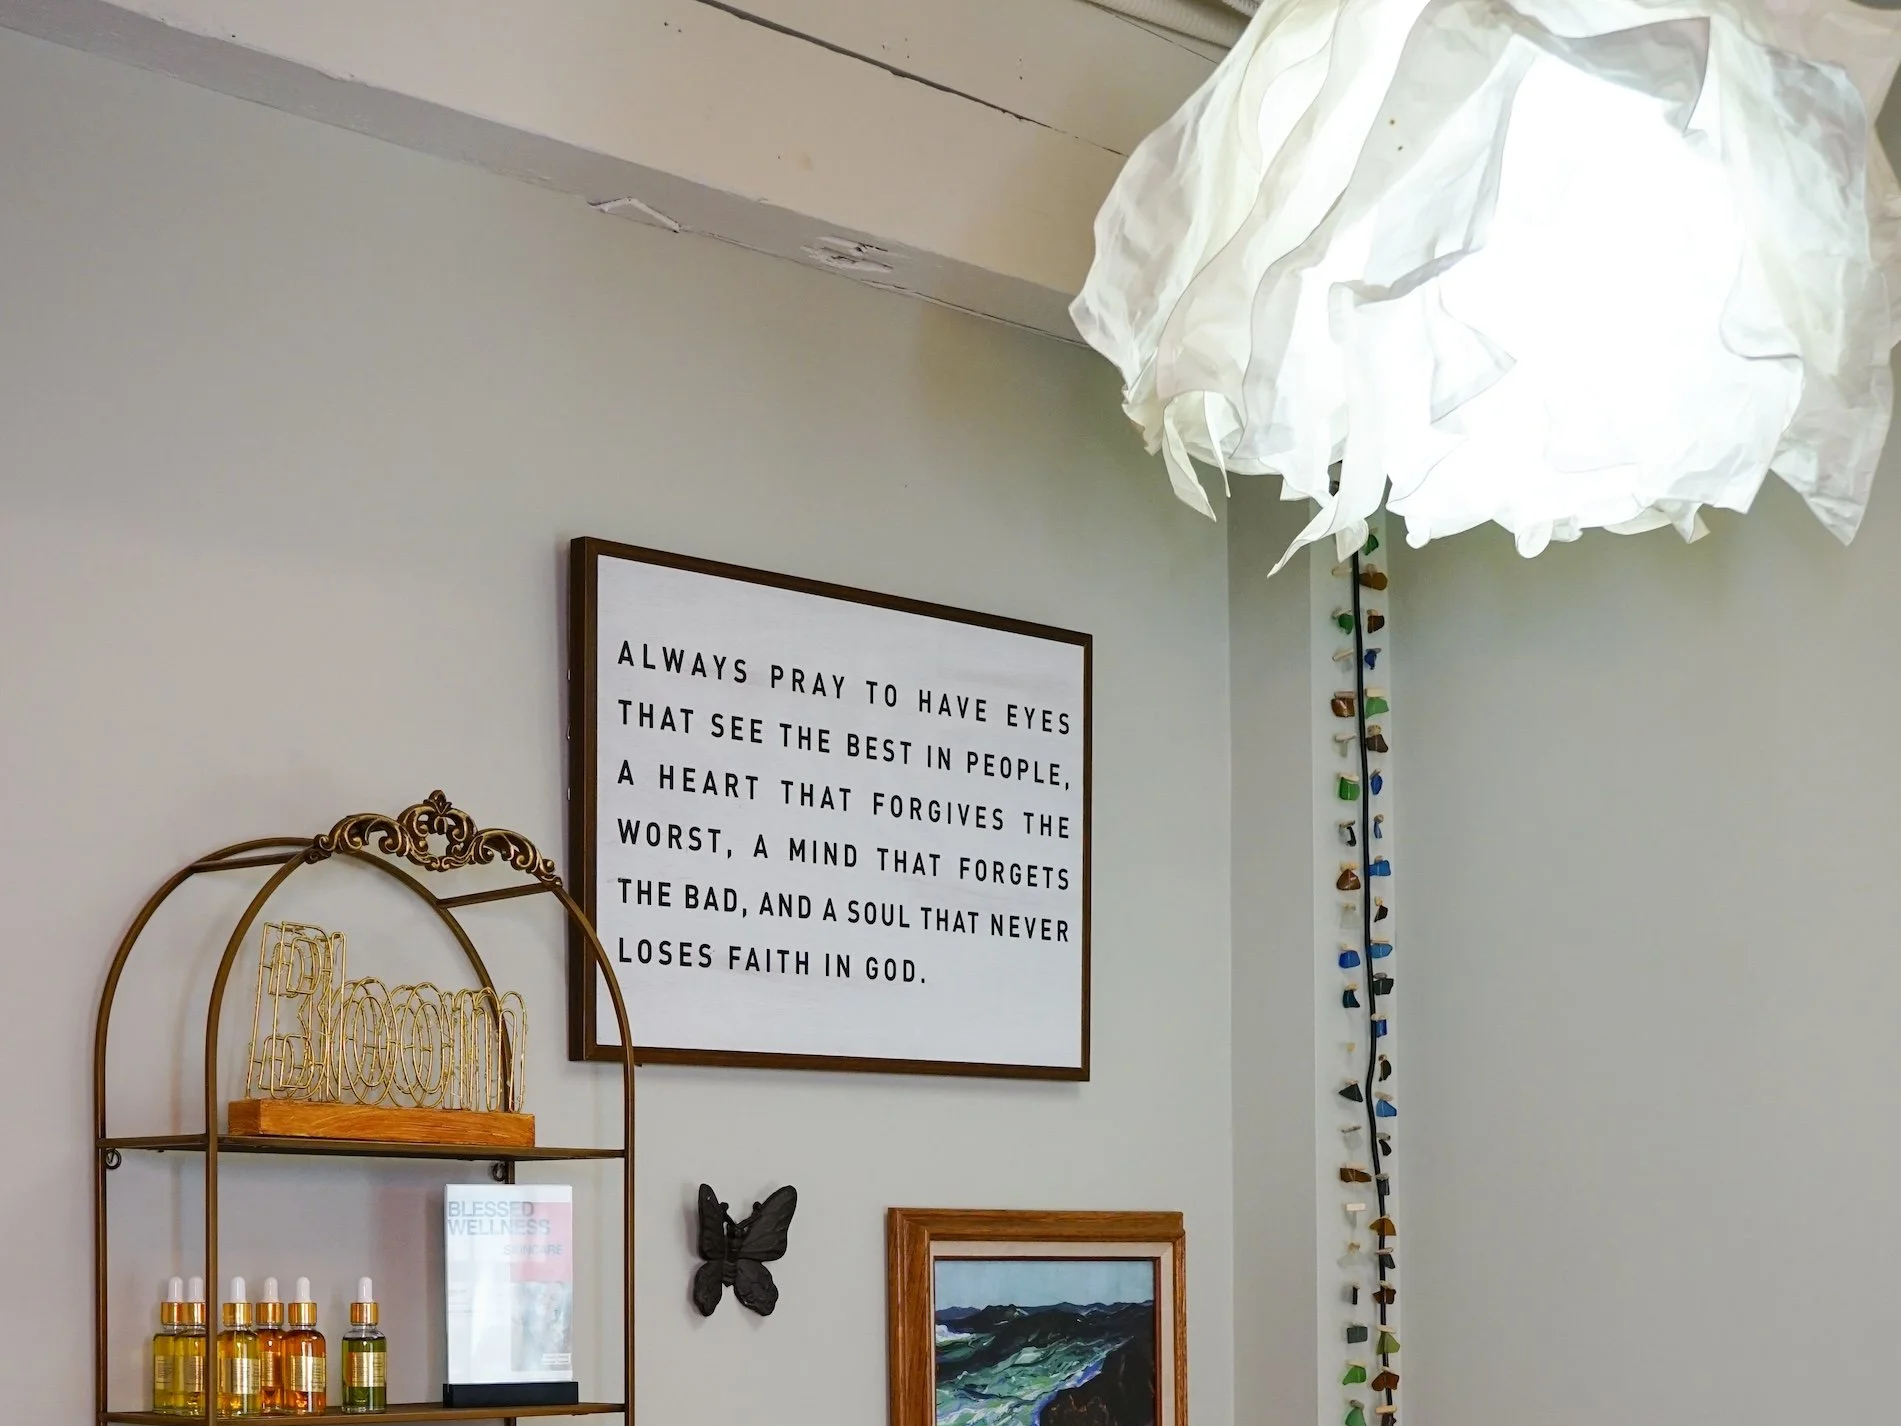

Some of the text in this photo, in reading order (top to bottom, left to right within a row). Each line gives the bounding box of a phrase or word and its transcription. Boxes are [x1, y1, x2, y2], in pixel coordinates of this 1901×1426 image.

[617, 640, 1070, 735] ALWAYS PRAY TO HAVE EYES
[617, 698, 1069, 791] THAT SEE THE BEST IN PEOPLE,
[617, 759, 1069, 839] A HEART THAT FORGIVES THE
[617, 818, 1069, 891] WORST, A MIND THAT FORGETS
[617, 877, 1069, 943] THE BAD, AND A SOUL THAT NEVER
[618, 936, 925, 984] LOSES FAITH IN GOD.
[448, 1201, 535, 1218] BLESSED
[448, 1219, 551, 1236] WELLNESS
[503, 1244, 564, 1256] SINCRE
